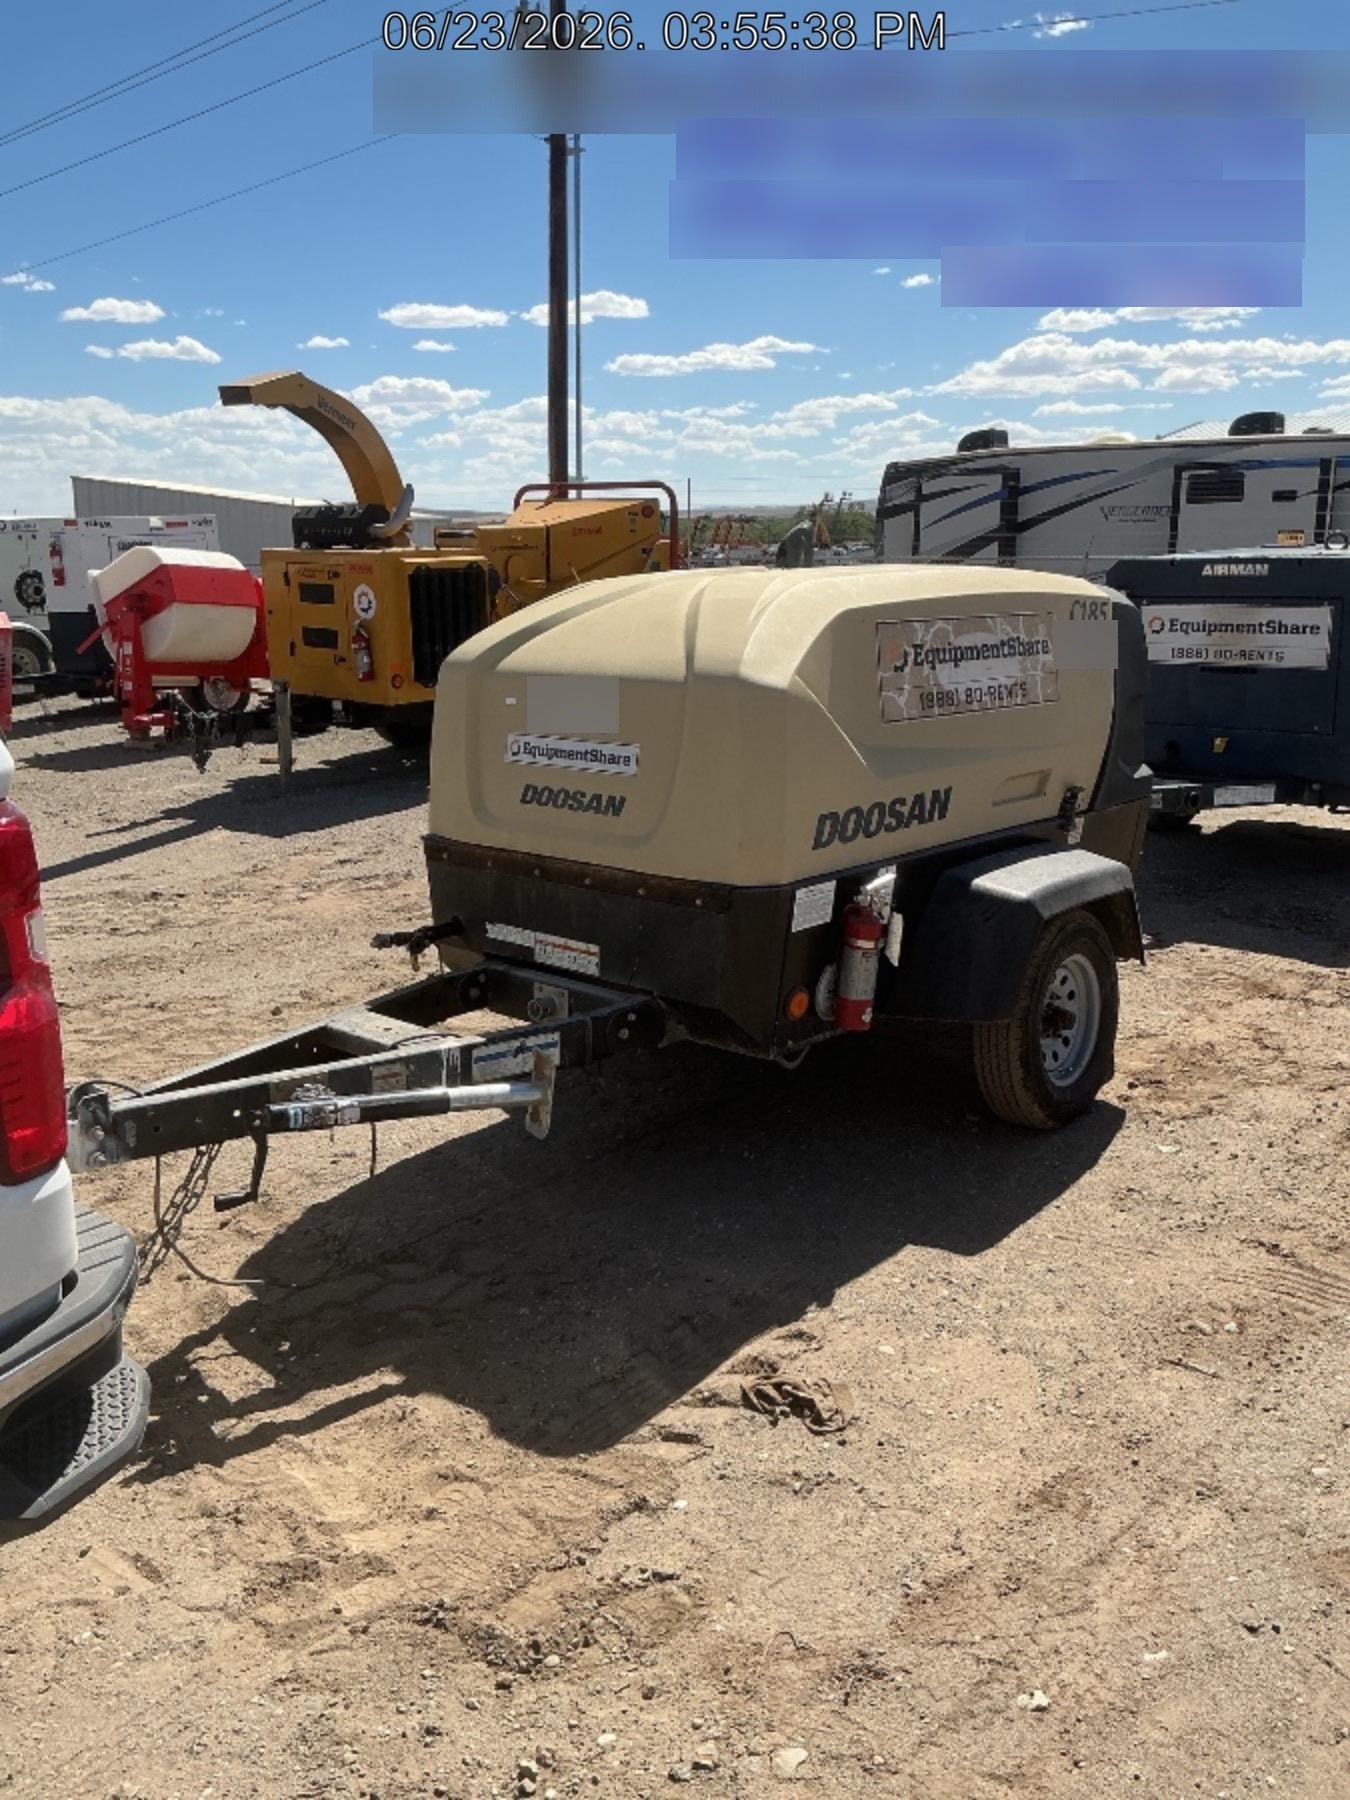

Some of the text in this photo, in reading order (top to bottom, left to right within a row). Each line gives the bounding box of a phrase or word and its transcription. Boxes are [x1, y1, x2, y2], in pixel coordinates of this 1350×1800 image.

[1201, 564, 1269, 577] AIRMAN
[1168, 618, 1321, 636] EquipmentShare
[911, 635, 1049, 671] EquipmentShare
[522, 741, 631, 767] EquipmentShare
[519, 783, 626, 817] DOOSAN
[811, 785, 953, 851] DOOSAN
